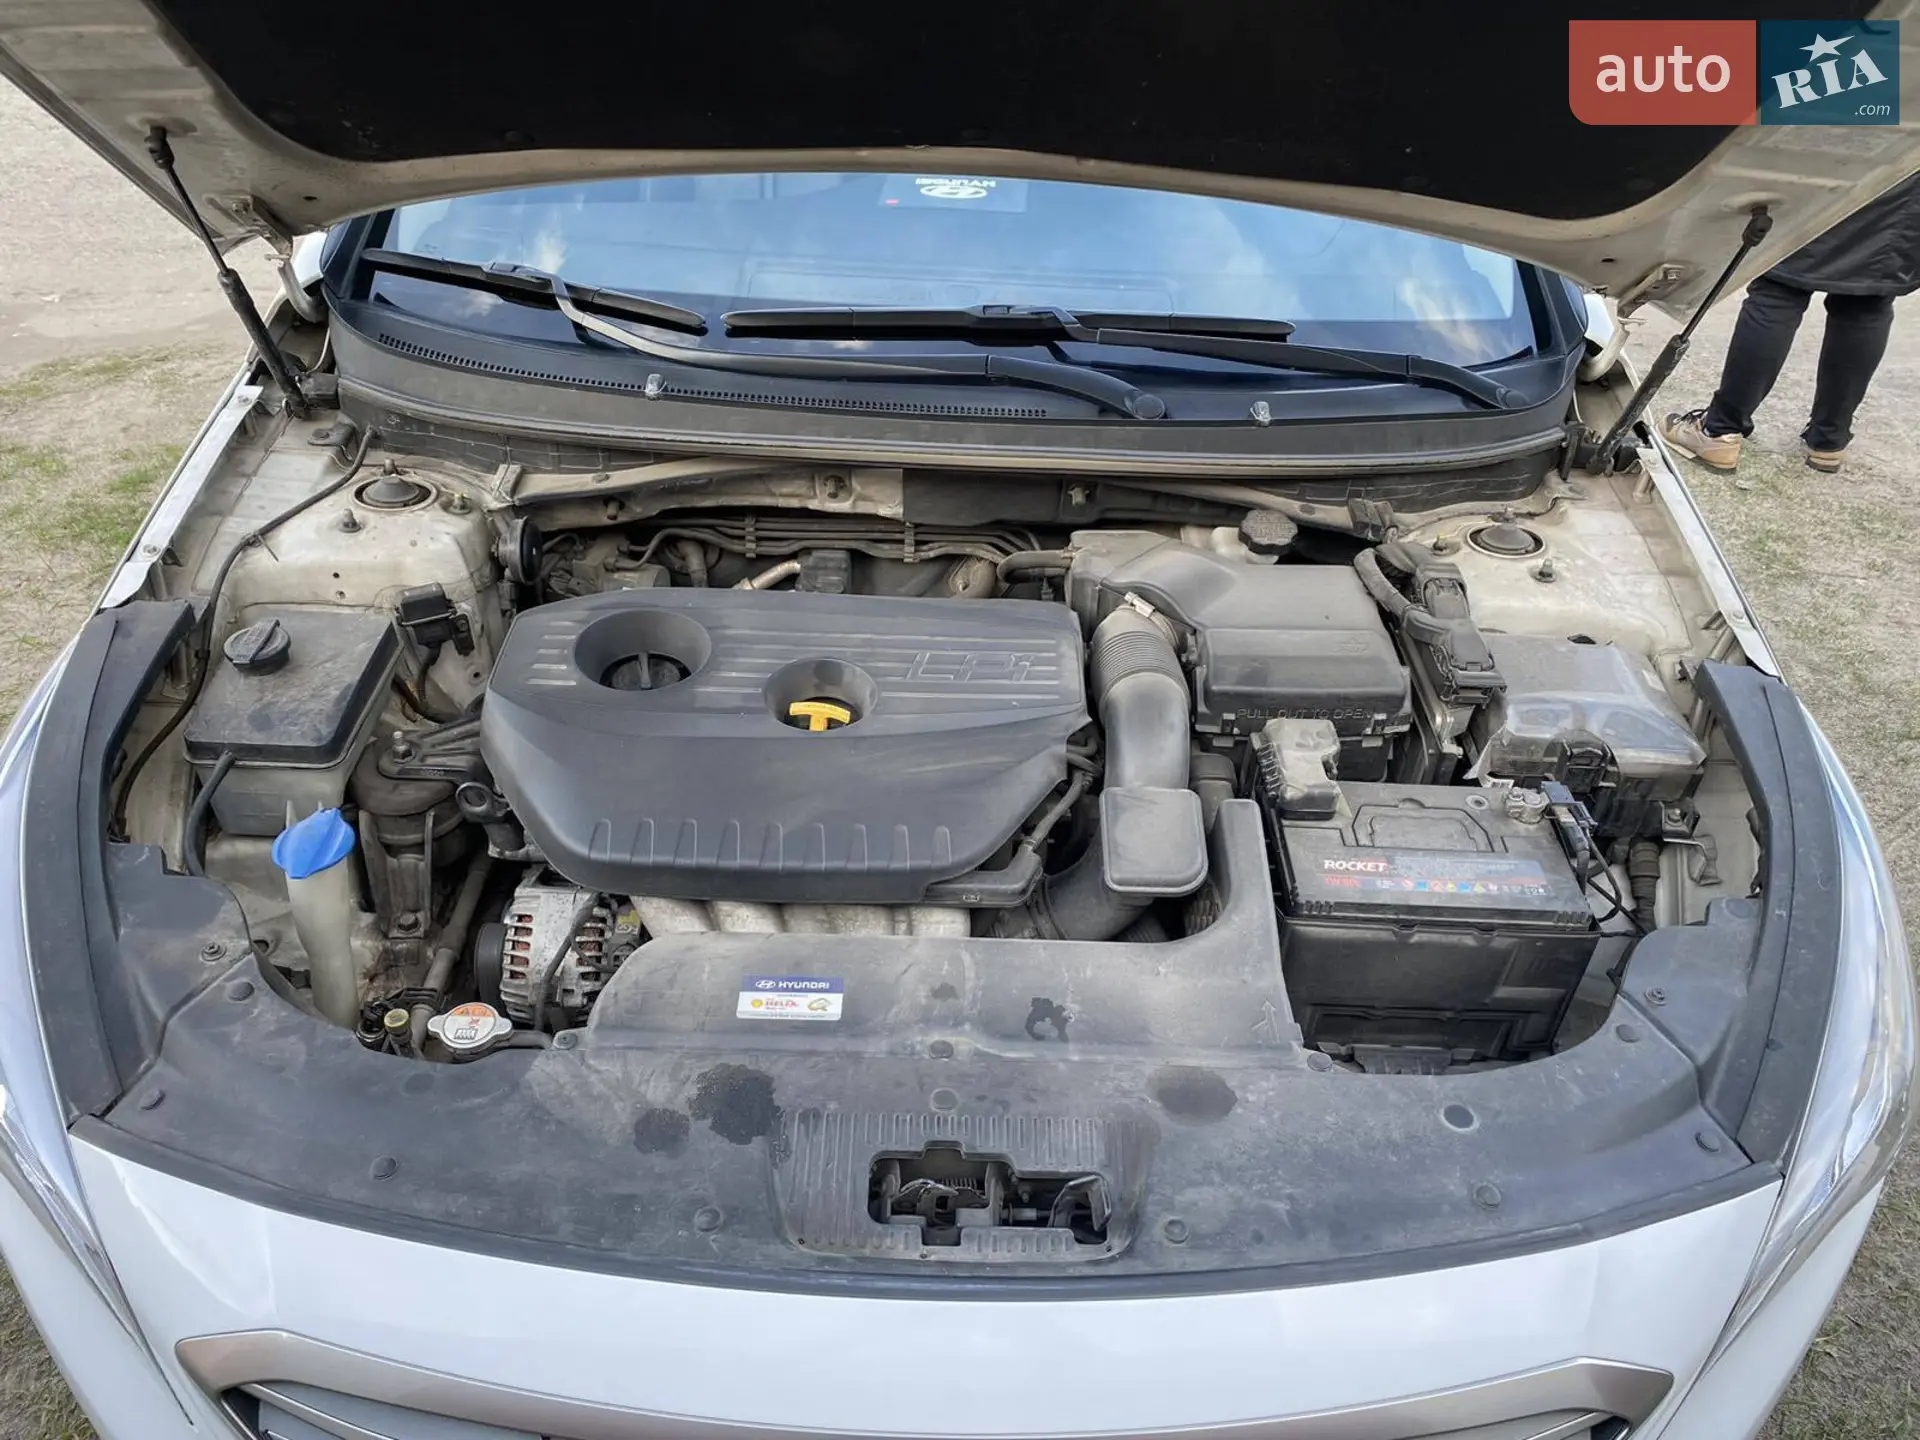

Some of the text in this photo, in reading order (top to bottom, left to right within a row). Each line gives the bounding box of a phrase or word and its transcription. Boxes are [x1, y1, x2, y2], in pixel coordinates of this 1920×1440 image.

[1237, 708, 1374, 720] PULL OUT TO OPEN
[1323, 859, 1387, 872] ROCKET
[778, 981, 830, 989] HYUNDAI
